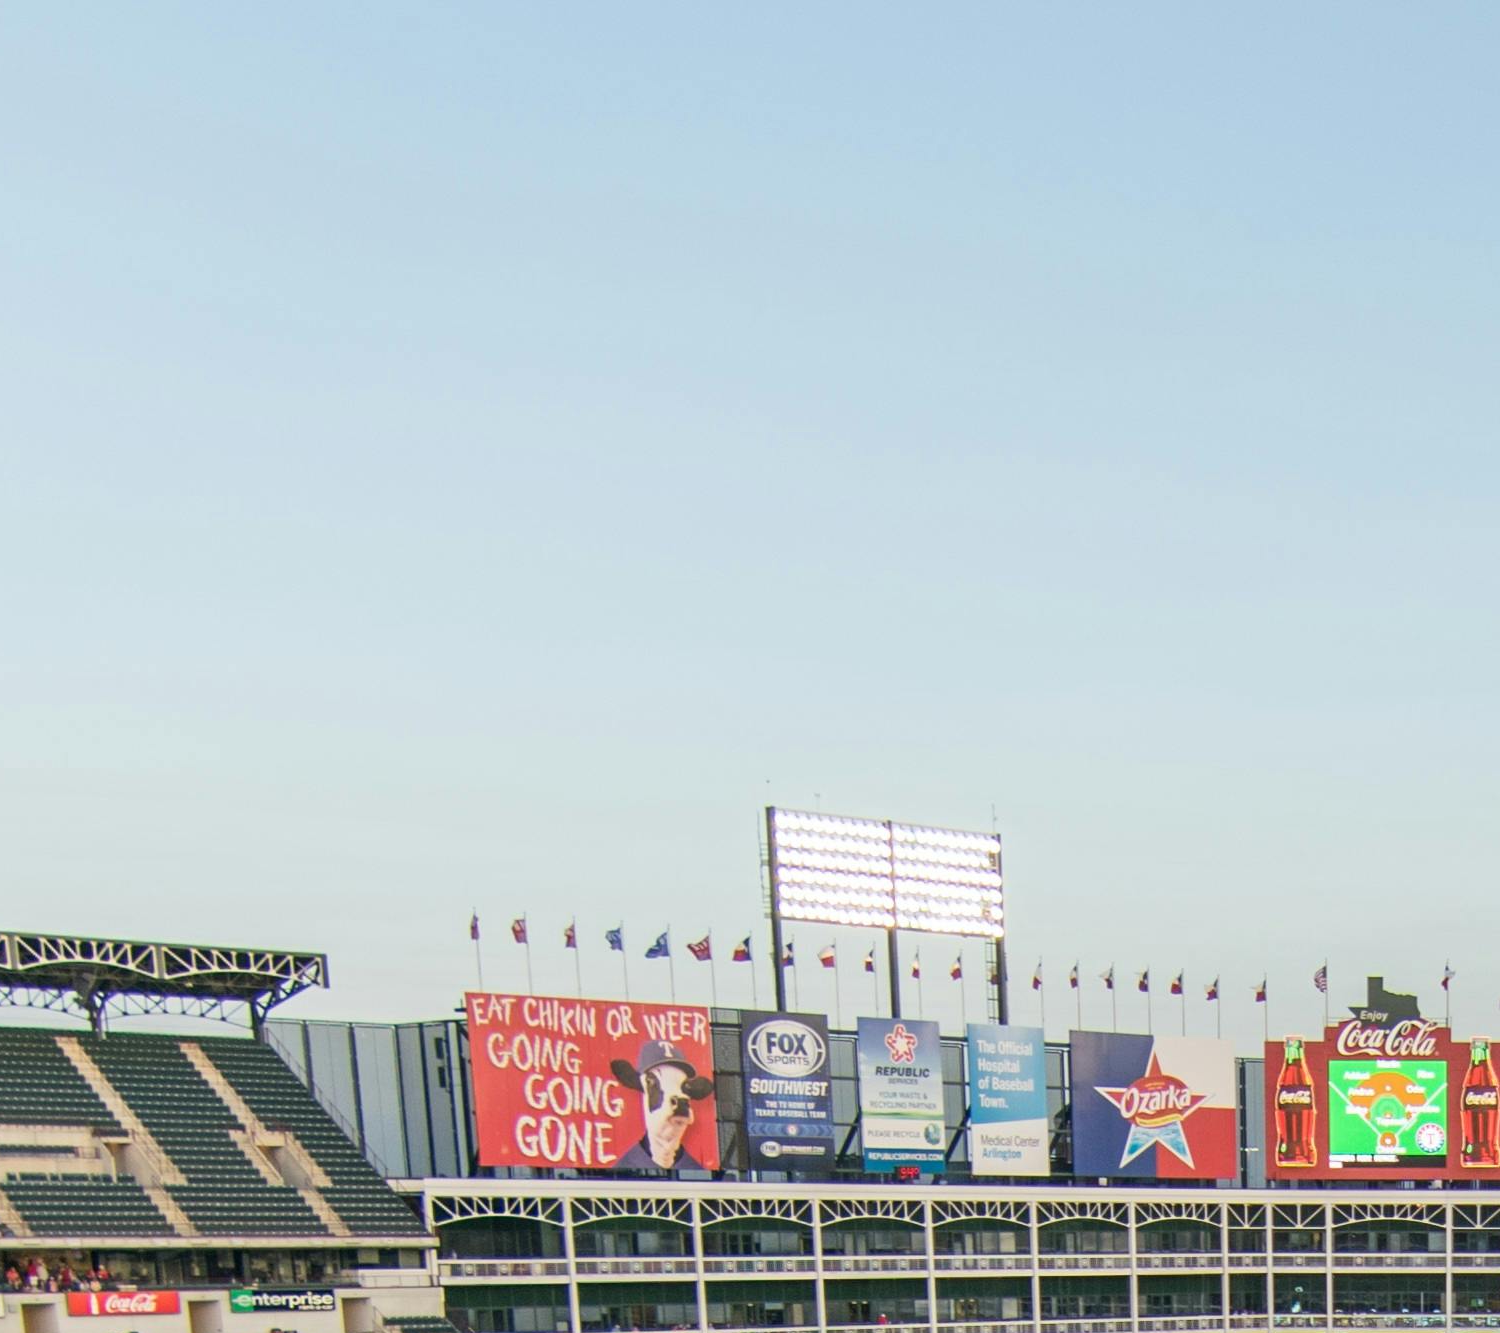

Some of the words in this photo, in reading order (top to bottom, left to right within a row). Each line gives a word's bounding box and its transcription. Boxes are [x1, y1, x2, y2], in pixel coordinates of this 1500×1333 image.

[472, 995, 516, 1026] EAT
[523, 997, 596, 1038] CHIKIN
[606, 1005, 638, 1041] OR
[644, 1011, 707, 1045] WEER
[1360, 1010, 1388, 1022] Enjoy
[766, 1032, 808, 1056] FOX
[1337, 1019, 1438, 1056] Coca-Cola
[486, 1032, 582, 1074] GOING
[658, 1041, 674, 1058] T
[976, 1040, 997, 1055] The
[999, 1041, 1033, 1056] Official
[766, 1056, 810, 1066] SPORTS
[978, 1059, 1020, 1075] Hospital
[875, 1066, 930, 1077] REPUBLIC
[750, 1078, 828, 1096] SOUTHWEST
[887, 1077, 918, 1085] SERVICES
[978, 1076, 990, 1090] of
[991, 1077, 1034, 1092] Baseball
[524, 1073, 624, 1118] GOING
[979, 1094, 1008, 1108] Town.
[1120, 1086, 1192, 1119] Ozarka
[515, 1115, 618, 1164] GONE
[981, 1135, 1012, 1147] Medical
[1014, 1136, 1040, 1148] Center
[982, 1148, 1022, 1161] Arlington
[105, 1293, 157, 1313] Coca-Cola
[233, 1290, 334, 1309] enterprise
